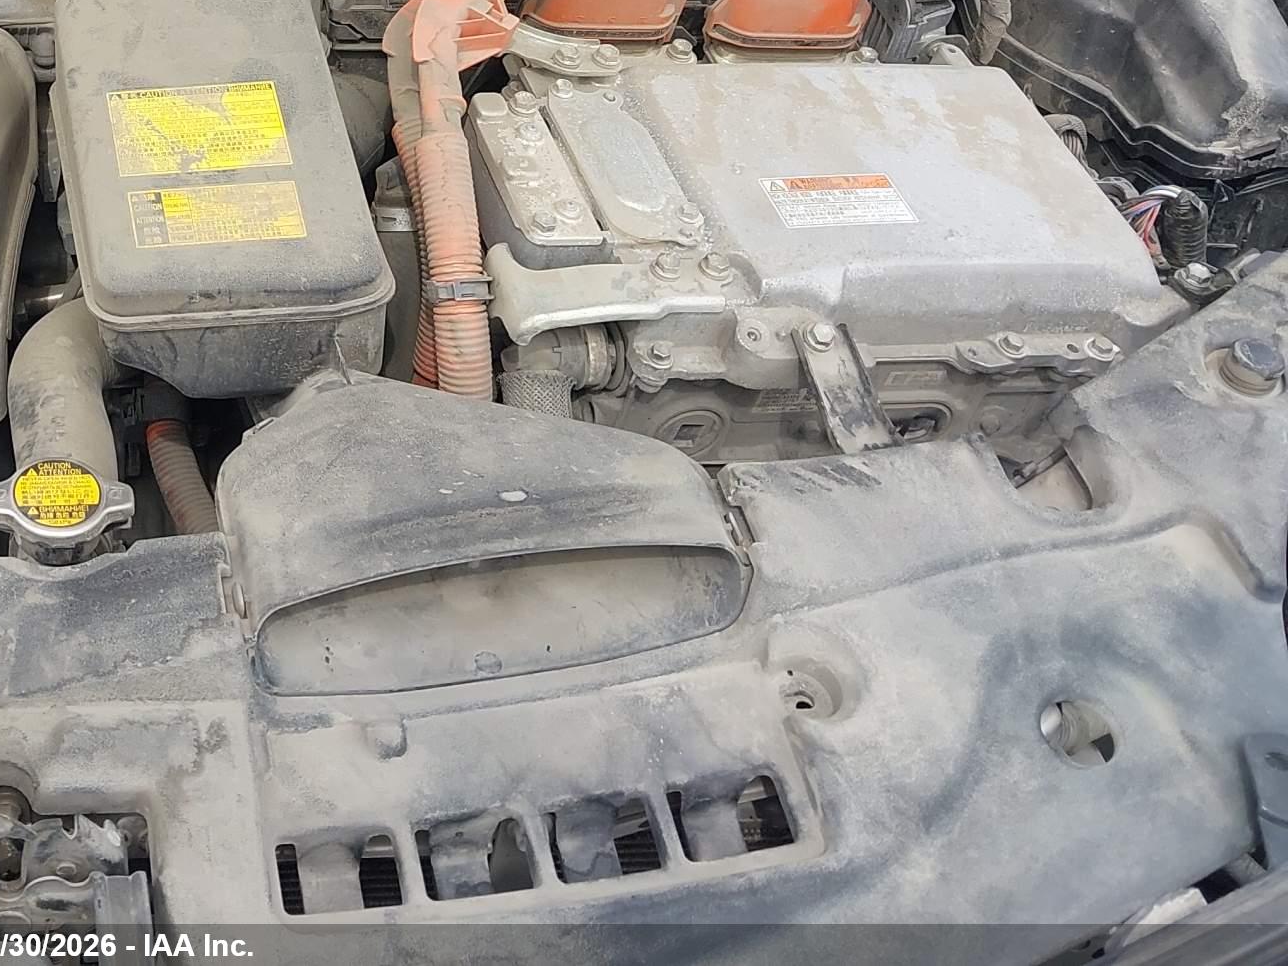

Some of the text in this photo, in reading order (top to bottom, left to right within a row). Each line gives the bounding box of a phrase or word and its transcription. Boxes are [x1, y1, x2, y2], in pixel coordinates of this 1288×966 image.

[139, 89, 177, 100] CAUTION
[179, 86, 226, 96] ATTENTION
[134, 202, 163, 212] CAUTION
[136, 216, 165, 225] ATTENTION
[37, 462, 72, 470] CAUTION
[38, 468, 82, 476] ATTENTION
